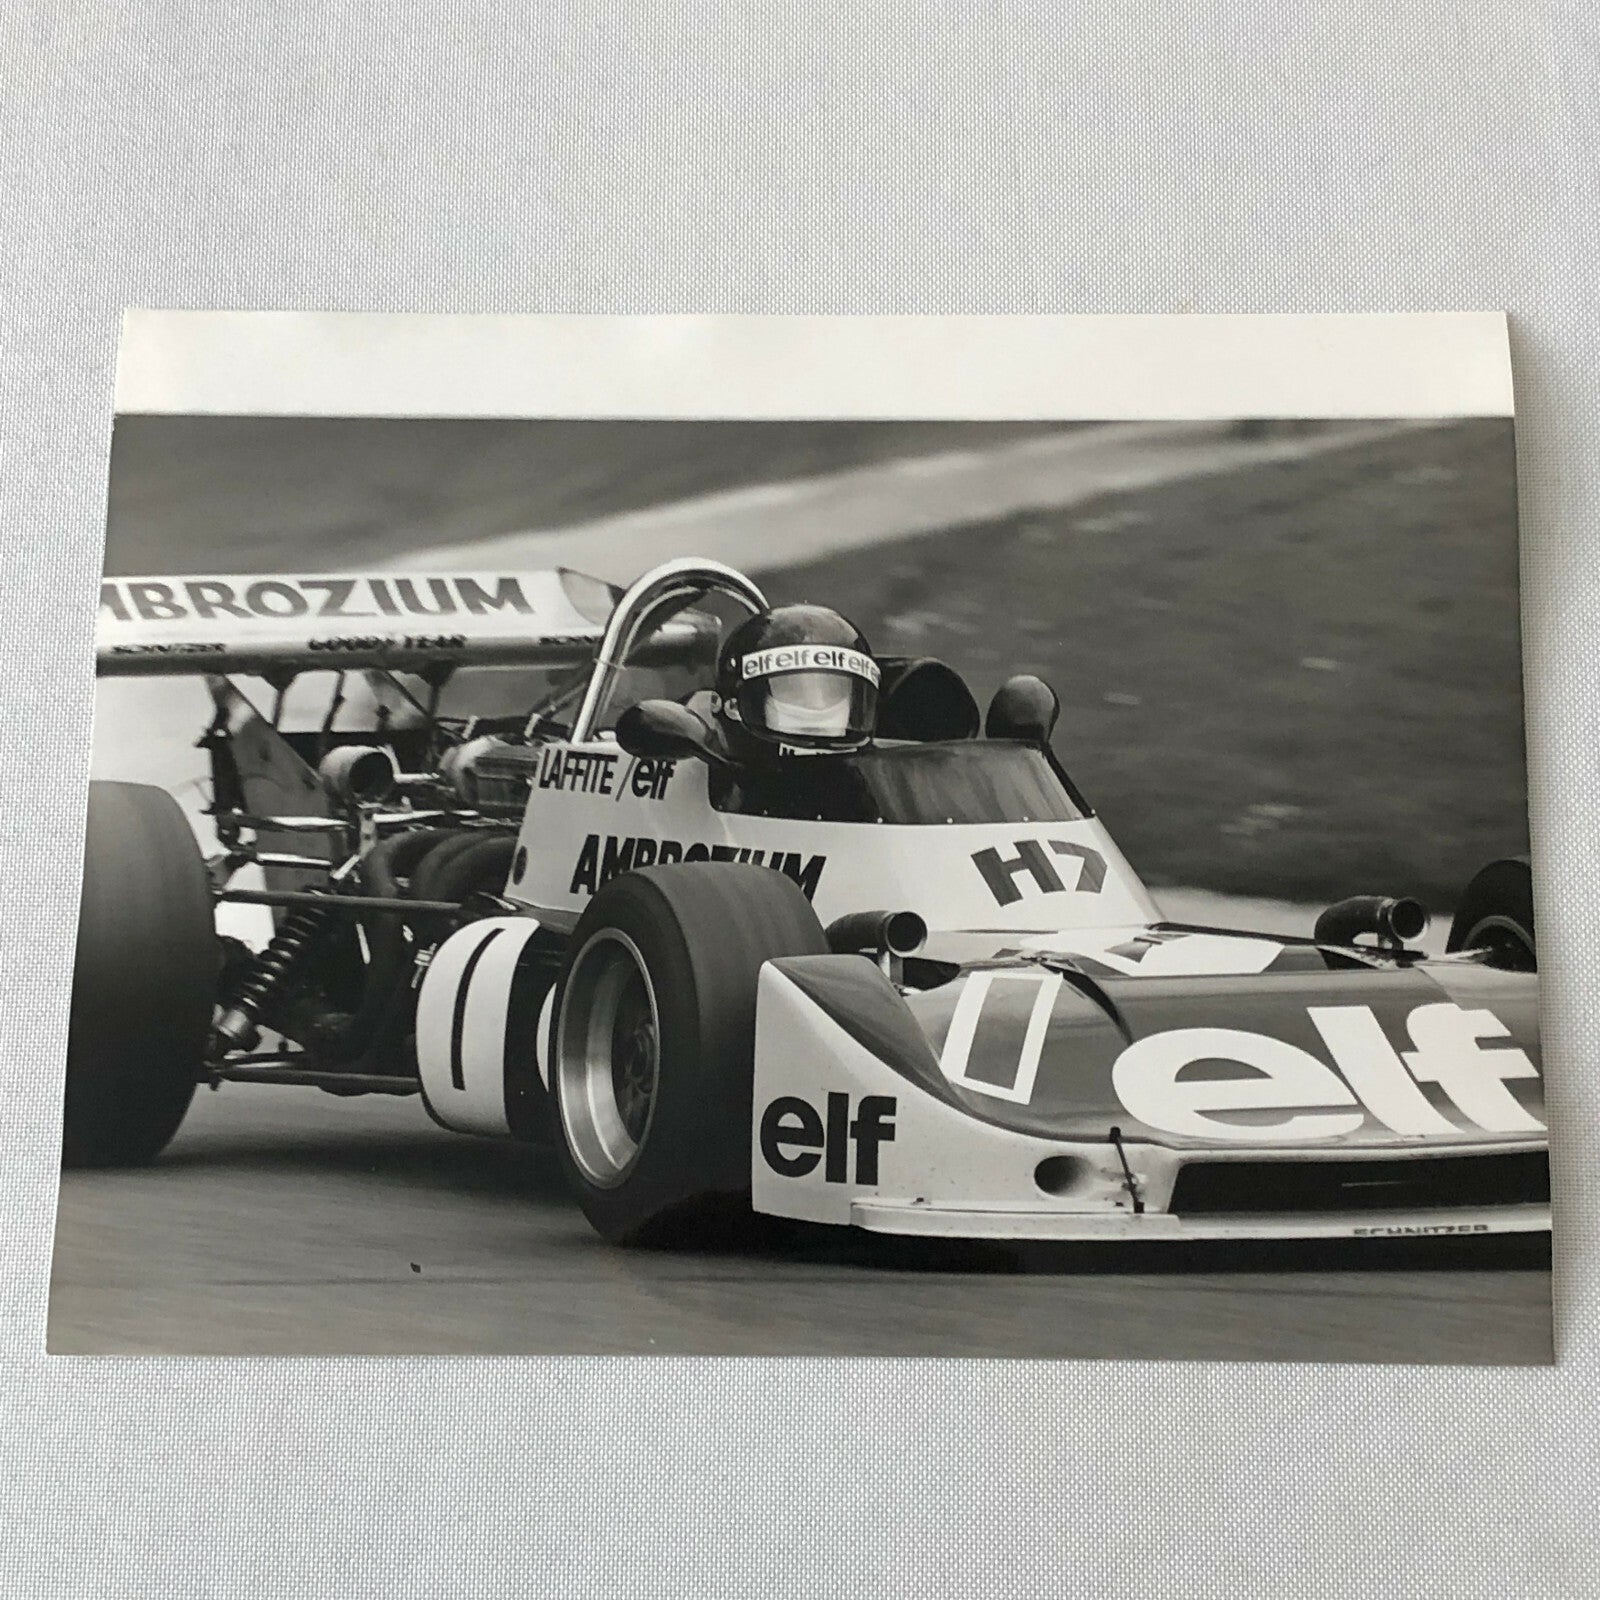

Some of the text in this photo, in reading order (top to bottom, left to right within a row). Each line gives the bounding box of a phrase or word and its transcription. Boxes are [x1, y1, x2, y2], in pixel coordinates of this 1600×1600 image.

[744, 655, 773, 676] elf
[775, 650, 810, 667] elf
[813, 651, 846, 667] elf
[1111, 1003, 1549, 1140] elf
[760, 1092, 897, 1187] elf
